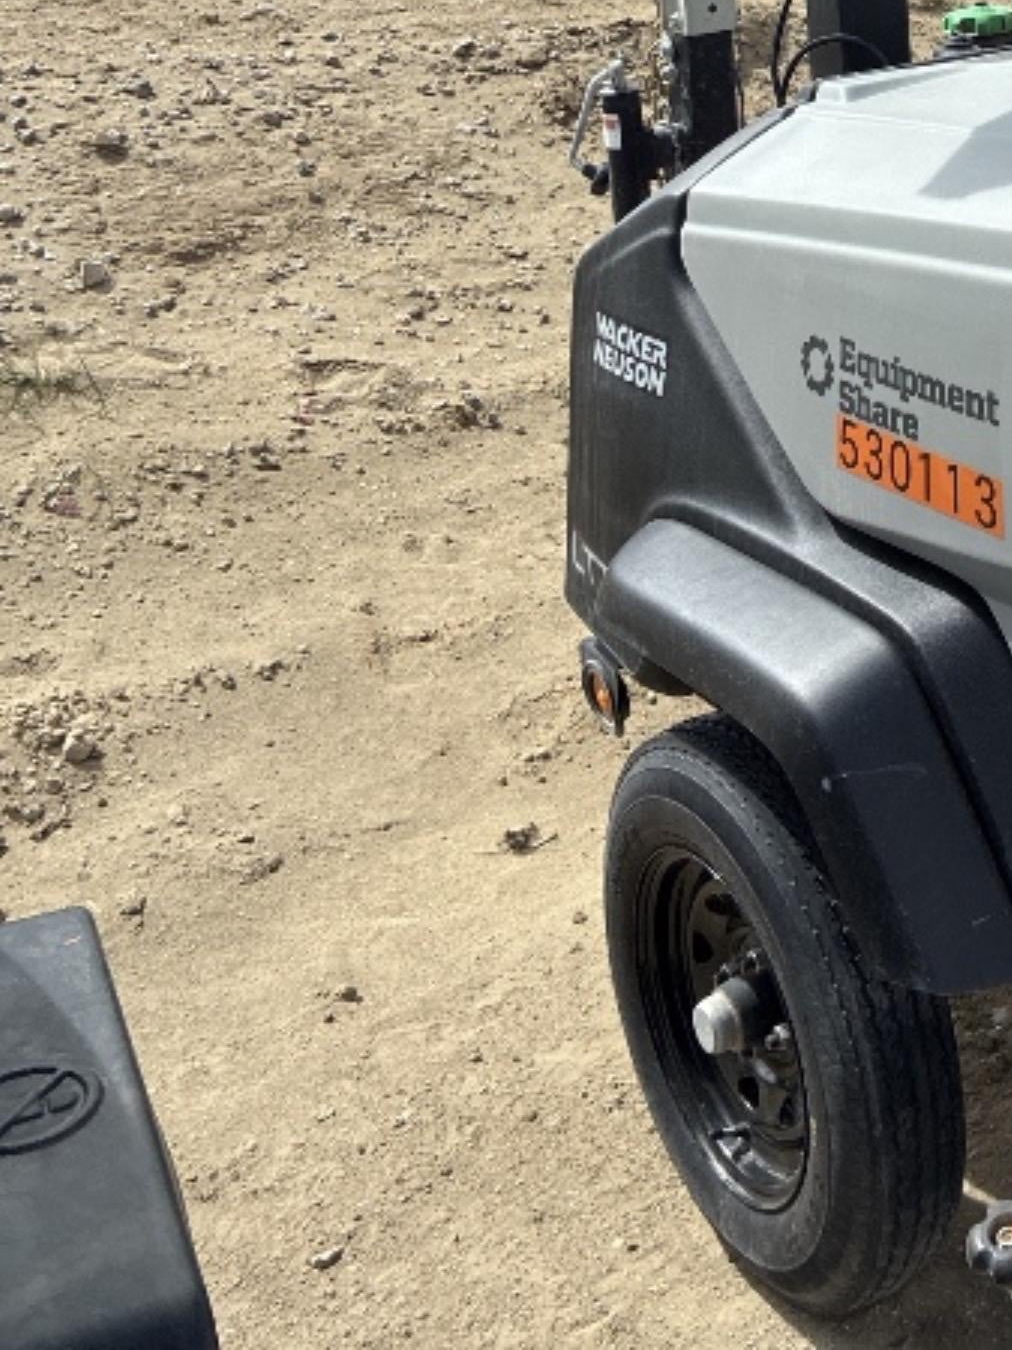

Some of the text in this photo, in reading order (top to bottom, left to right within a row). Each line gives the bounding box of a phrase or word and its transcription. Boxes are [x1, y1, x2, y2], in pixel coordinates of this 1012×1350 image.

[593, 338, 668, 397] NEUSON
[595, 311, 668, 370] WACKER
[839, 336, 1000, 427] Equipment
[839, 380, 919, 440] Share
[839, 417, 997, 530] 530113
